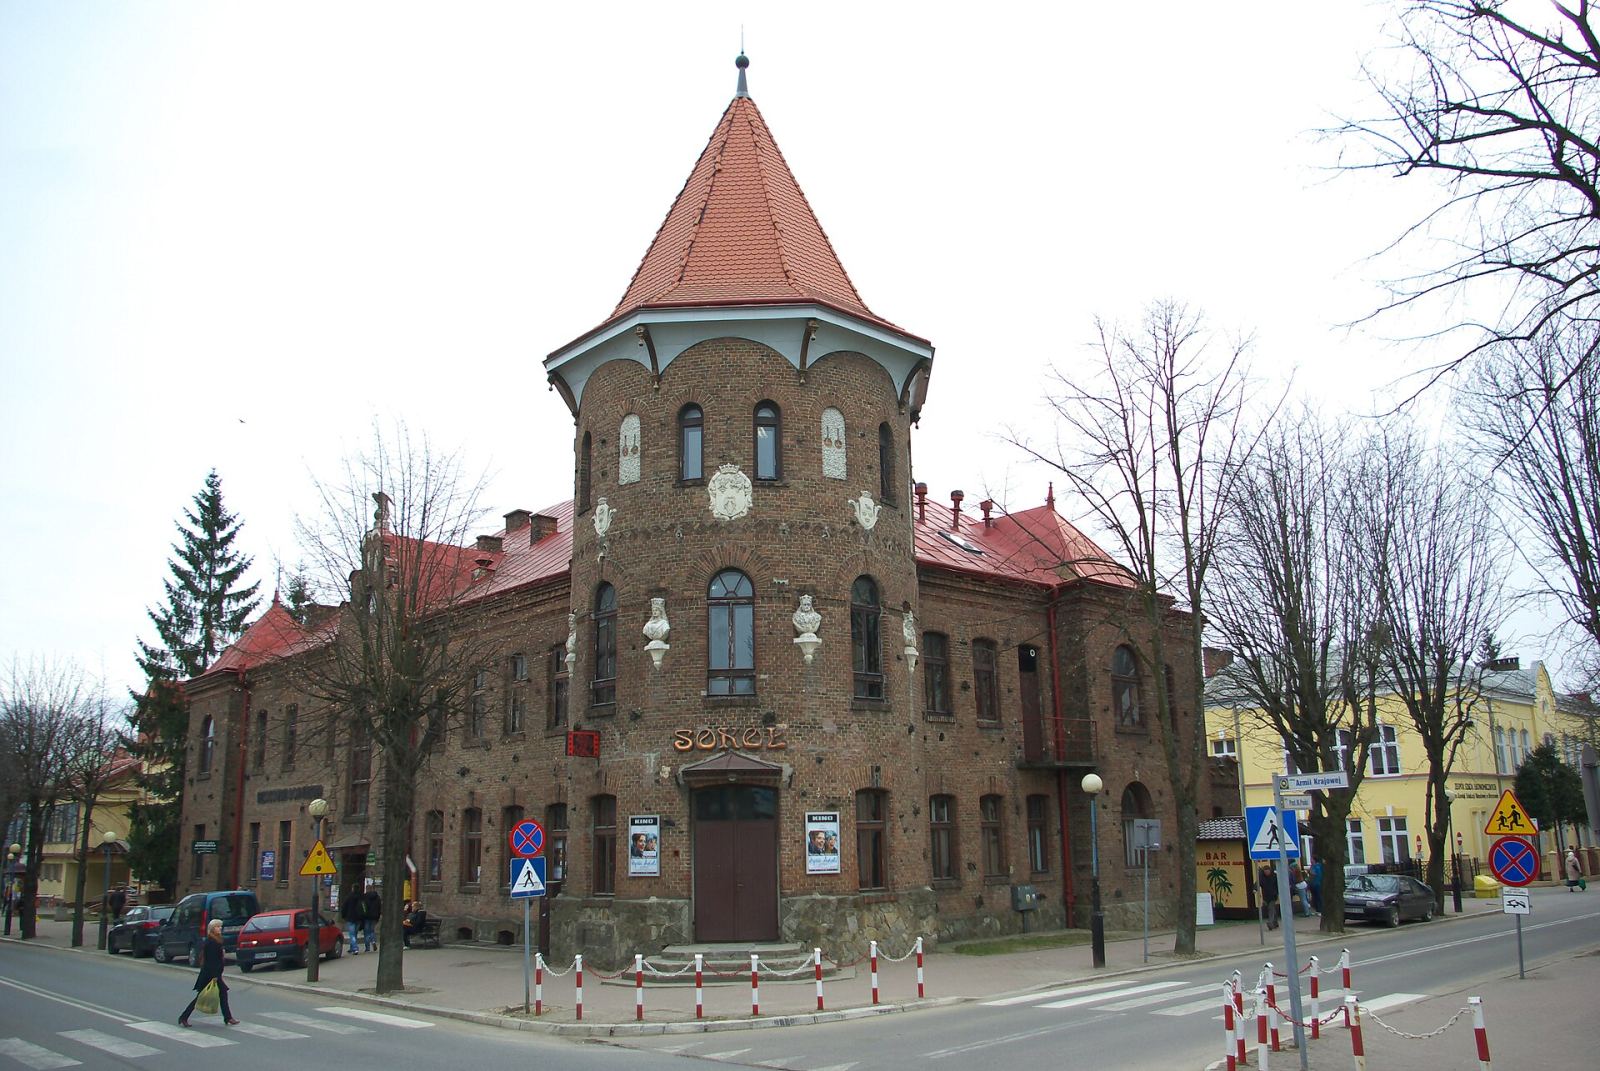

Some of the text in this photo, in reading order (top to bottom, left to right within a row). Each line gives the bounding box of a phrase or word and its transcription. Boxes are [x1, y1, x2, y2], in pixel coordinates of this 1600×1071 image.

[1295, 776, 1341, 787] Armii Krajowej
[1205, 852, 1227, 860] BAR
